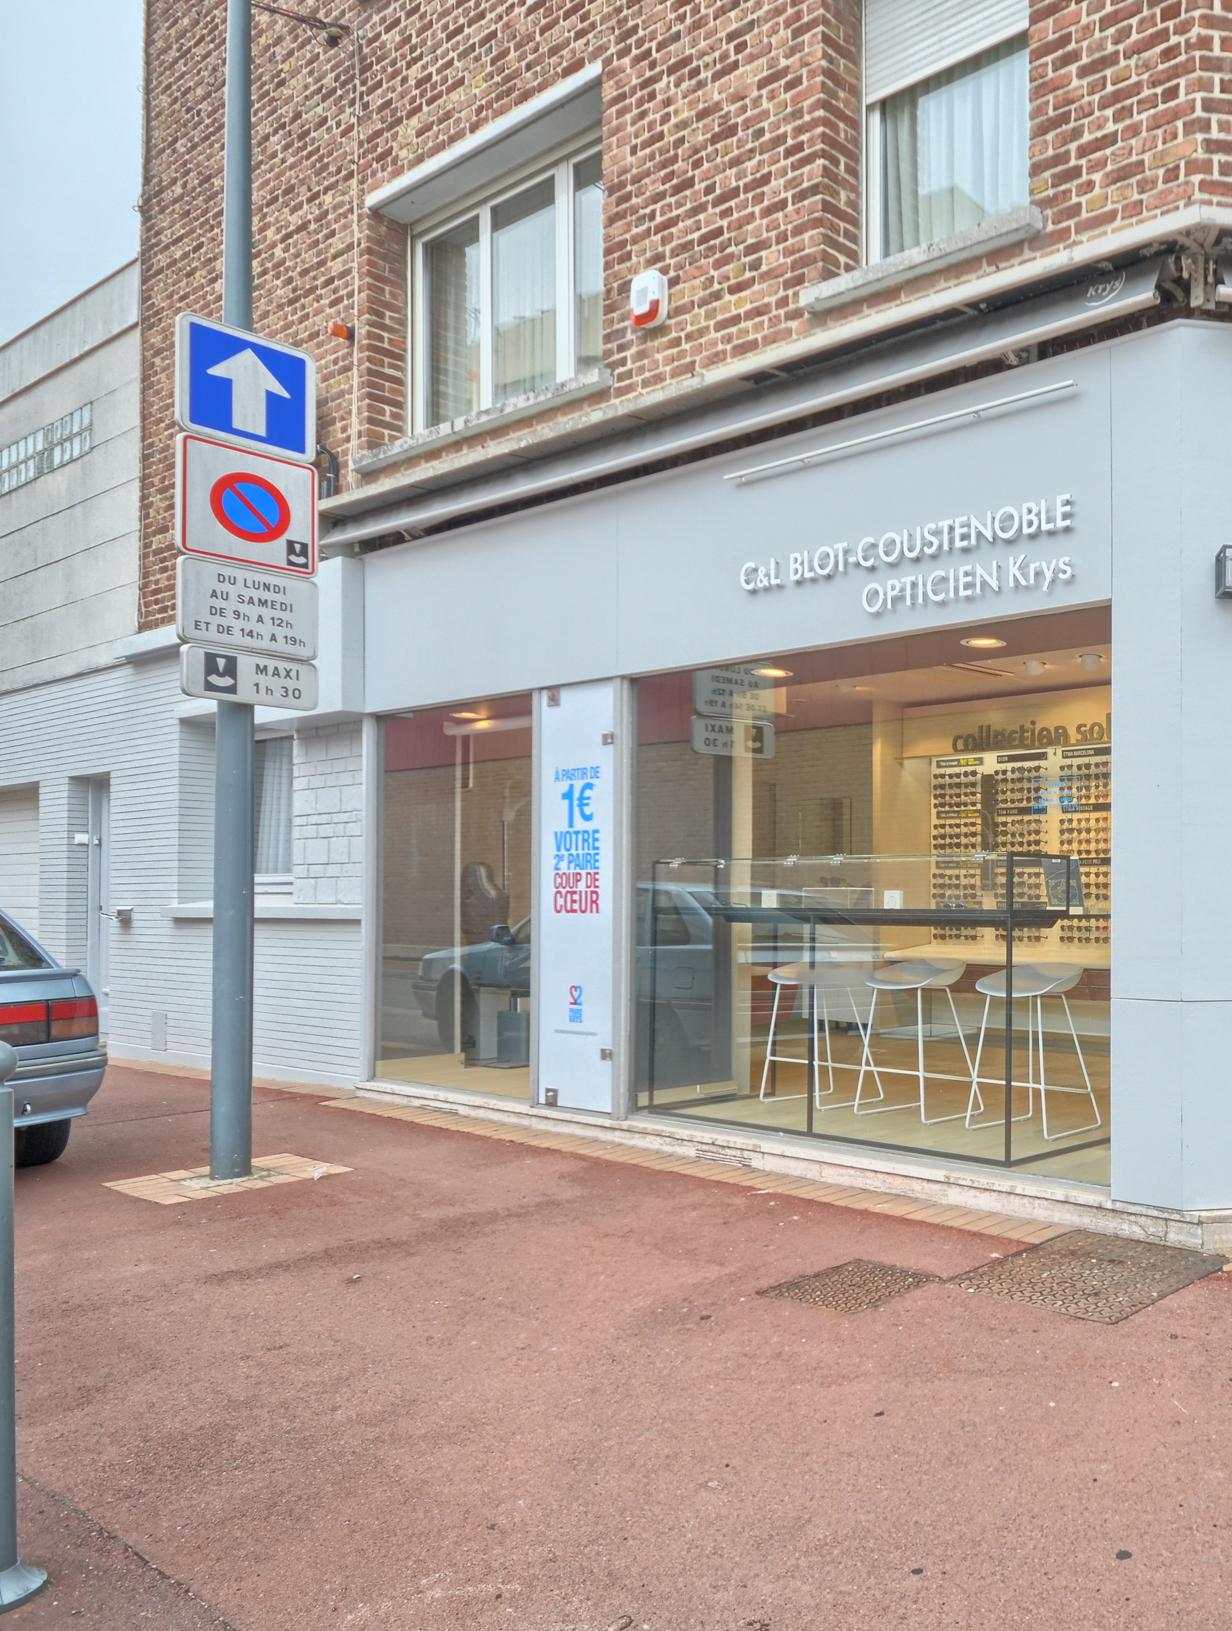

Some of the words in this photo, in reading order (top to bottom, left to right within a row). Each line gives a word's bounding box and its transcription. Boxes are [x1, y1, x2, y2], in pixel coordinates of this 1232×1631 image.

[740, 557, 782, 590] C&L
[789, 493, 1073, 582] BLOT-COUSTENOBLE
[217, 573, 236, 586] DU
[243, 578, 287, 596] LUNDI
[862, 560, 1000, 613] OPTICIEN
[1008, 554, 1073, 592] Krys
[210, 589, 229, 602] AU
[237, 594, 294, 613] SAMEDI
[209, 605, 227, 618] DE
[233, 610, 250, 622] 9h
[256, 614, 264, 624] A
[270, 616, 293, 630] 12h
[194, 620, 211, 632] ET
[216, 624, 235, 636] DE
[240, 628, 264, 641] 14h
[269, 633, 278, 643] A
[284, 635, 306, 648] 19h
[255, 663, 300, 681] MAXI
[253, 683, 260, 694] 1
[265, 685, 274, 696] h
[280, 686, 302, 700] 30
[561, 766, 588, 782] PARTIR
[589, 765, 600, 780] DE
[561, 782, 595, 829] 1€
[554, 829, 600, 852] VOTRE
[567, 852, 600, 871] PAIRE
[554, 872, 582, 889] COUP
[585, 872, 600, 889] DE
[553, 890, 600, 914] CŒUR
